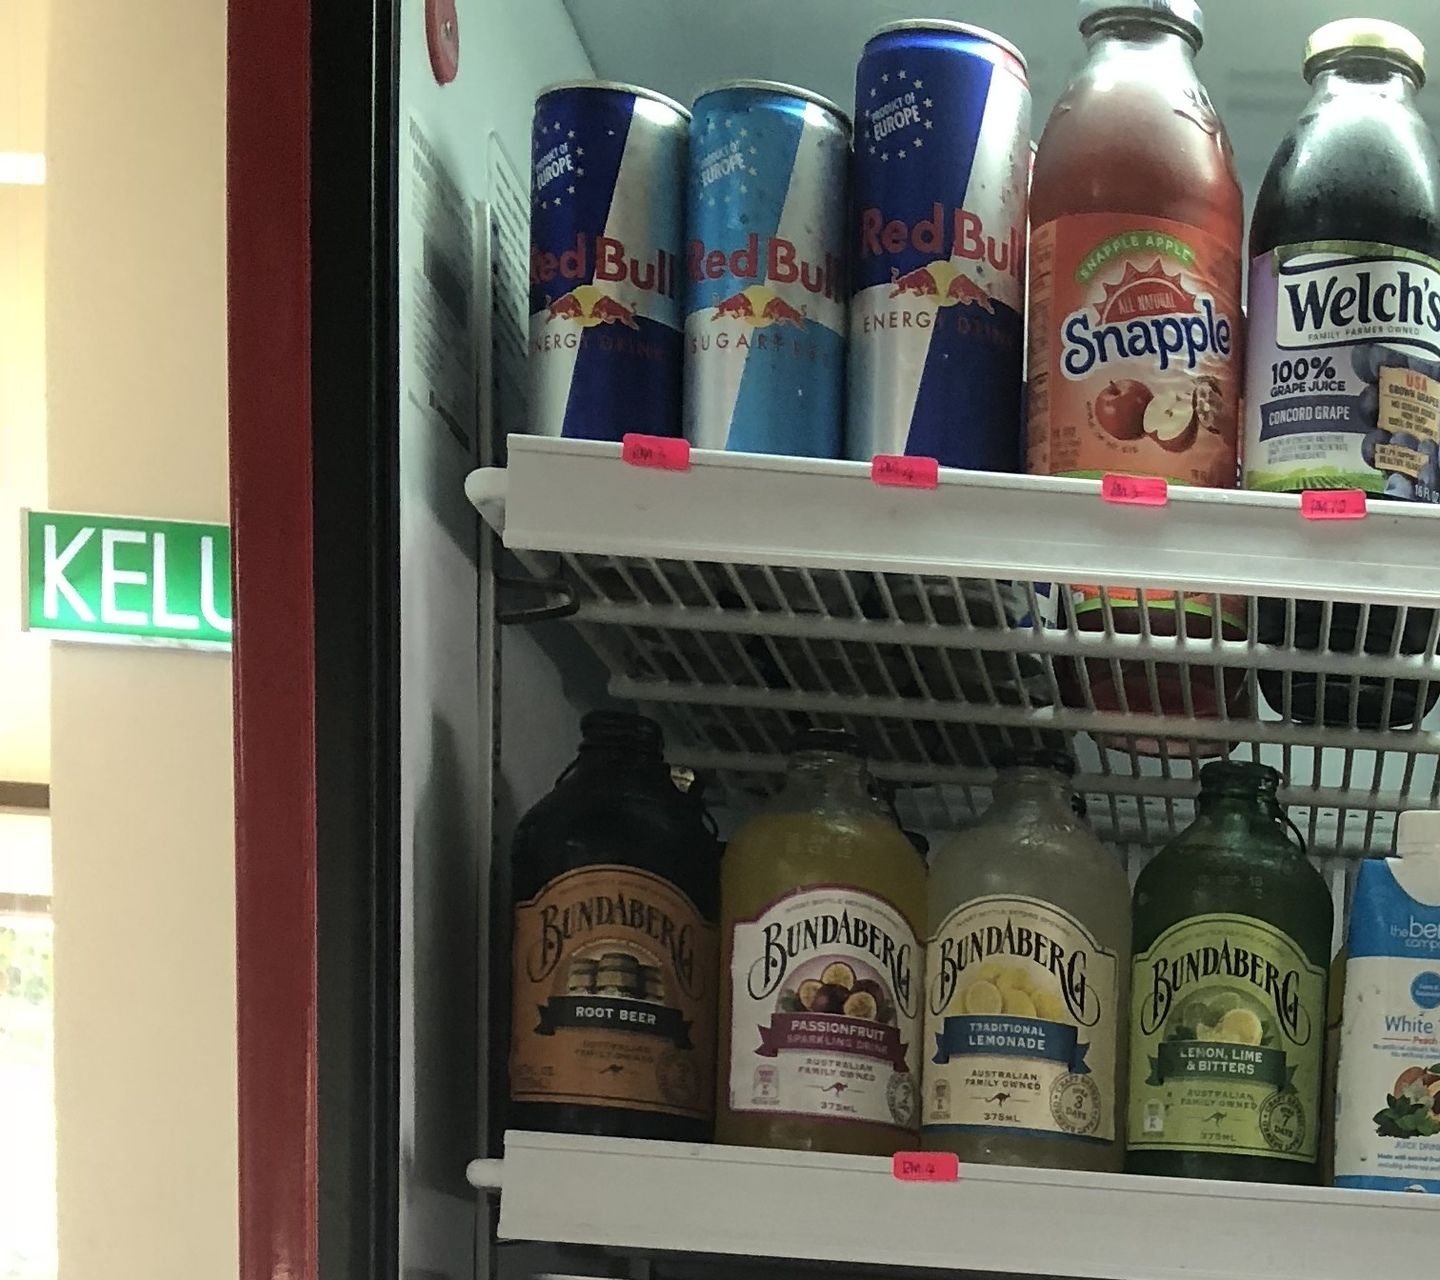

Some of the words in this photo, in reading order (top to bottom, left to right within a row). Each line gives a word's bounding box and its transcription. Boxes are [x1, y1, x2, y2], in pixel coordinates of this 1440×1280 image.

[873, 103, 921, 140] EUROPE
[536, 154, 574, 190] EUROPE
[863, 203, 943, 257] Red
[954, 208, 1023, 273] Bull
[595, 236, 676, 295] Bull
[1080, 237, 1139, 278] SNAPPLE
[1146, 236, 1192, 262] APPLE
[1066, 298, 1230, 375] Snapple
[1308, 331, 1341, 342] FAMILY
[1345, 325, 1384, 336] FARMER
[1387, 326, 1420, 336] OWNED
[1271, 356, 1336, 385] 100%
[1271, 382, 1306, 397] GRAPE
[1308, 380, 1346, 393] JUICE
[1269, 406, 1312, 426] CONCORD
[1315, 405, 1350, 421] GRAPE
[1390, 924, 1408, 937] the
[527, 892, 697, 995] BUNDABERG
[748, 909, 918, 1020] BUNDABERG
[930, 917, 1100, 1027] BUNDABERG
[1141, 937, 1311, 1047] BUNDABERG
[575, 1006, 603, 1019] ROOT
[619, 1009, 657, 1026] BEER
[1385, 1014, 1434, 1035] White
[791, 1020, 886, 1042] PASSIONFRUIT
[969, 1021, 1046, 1037] TRADITIONAL
[968, 1034, 1046, 1052] LEMONADE
[1179, 1047, 1228, 1062] LEMON,
[1231, 1049, 1263, 1064] LIME
[971, 1068, 1038, 1081] AUSTRALIAN
[1186, 1060, 1197, 1071] &
[1199, 1060, 1256, 1075] BITTERS
[964, 1077, 999, 1089] FAMILY
[1001, 1079, 1042, 1092] OWNED
